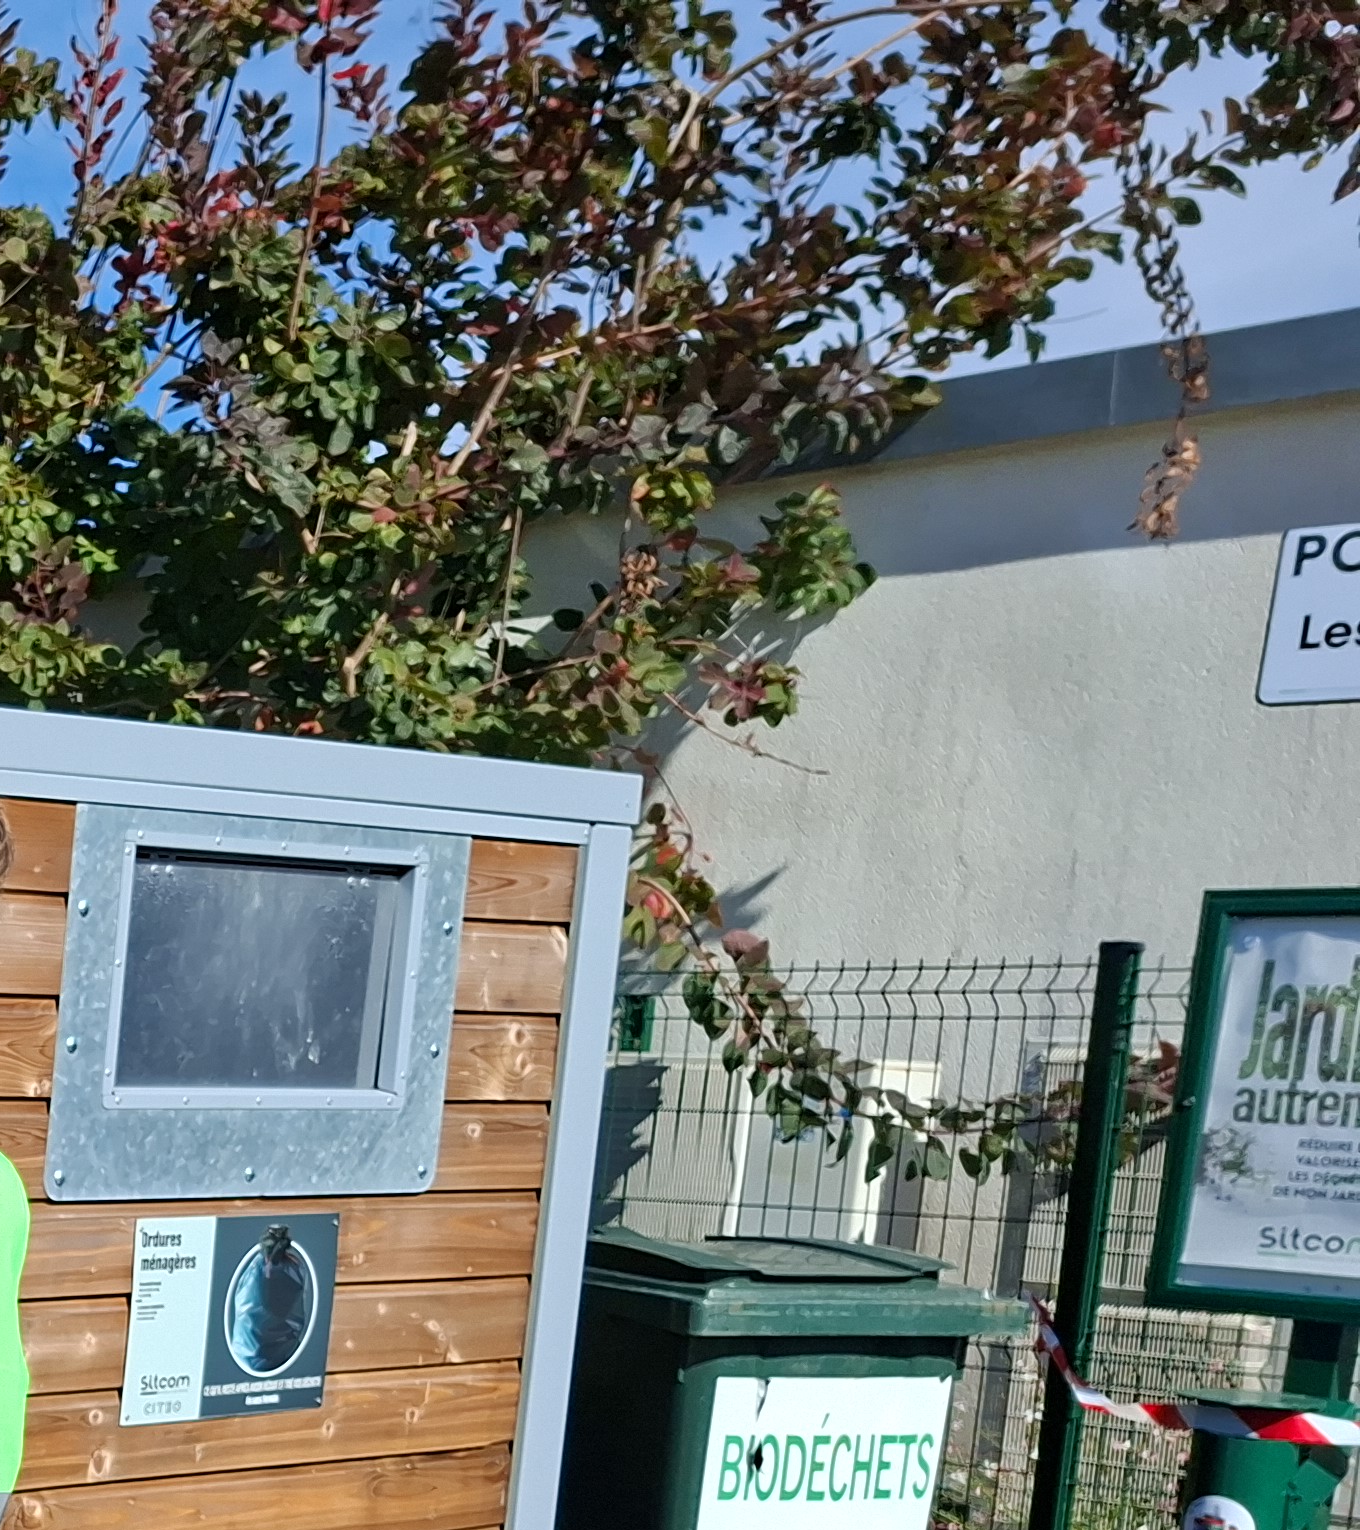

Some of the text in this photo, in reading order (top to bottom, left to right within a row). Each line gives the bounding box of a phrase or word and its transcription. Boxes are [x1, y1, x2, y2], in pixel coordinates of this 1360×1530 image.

[1299, 614, 1360, 649] Le
[141, 1230, 182, 1248] Ordures
[140, 1252, 196, 1274] ménagères
[141, 1374, 190, 1391] Sitcom
[717, 1412, 934, 1501] BIODÉCHETS
